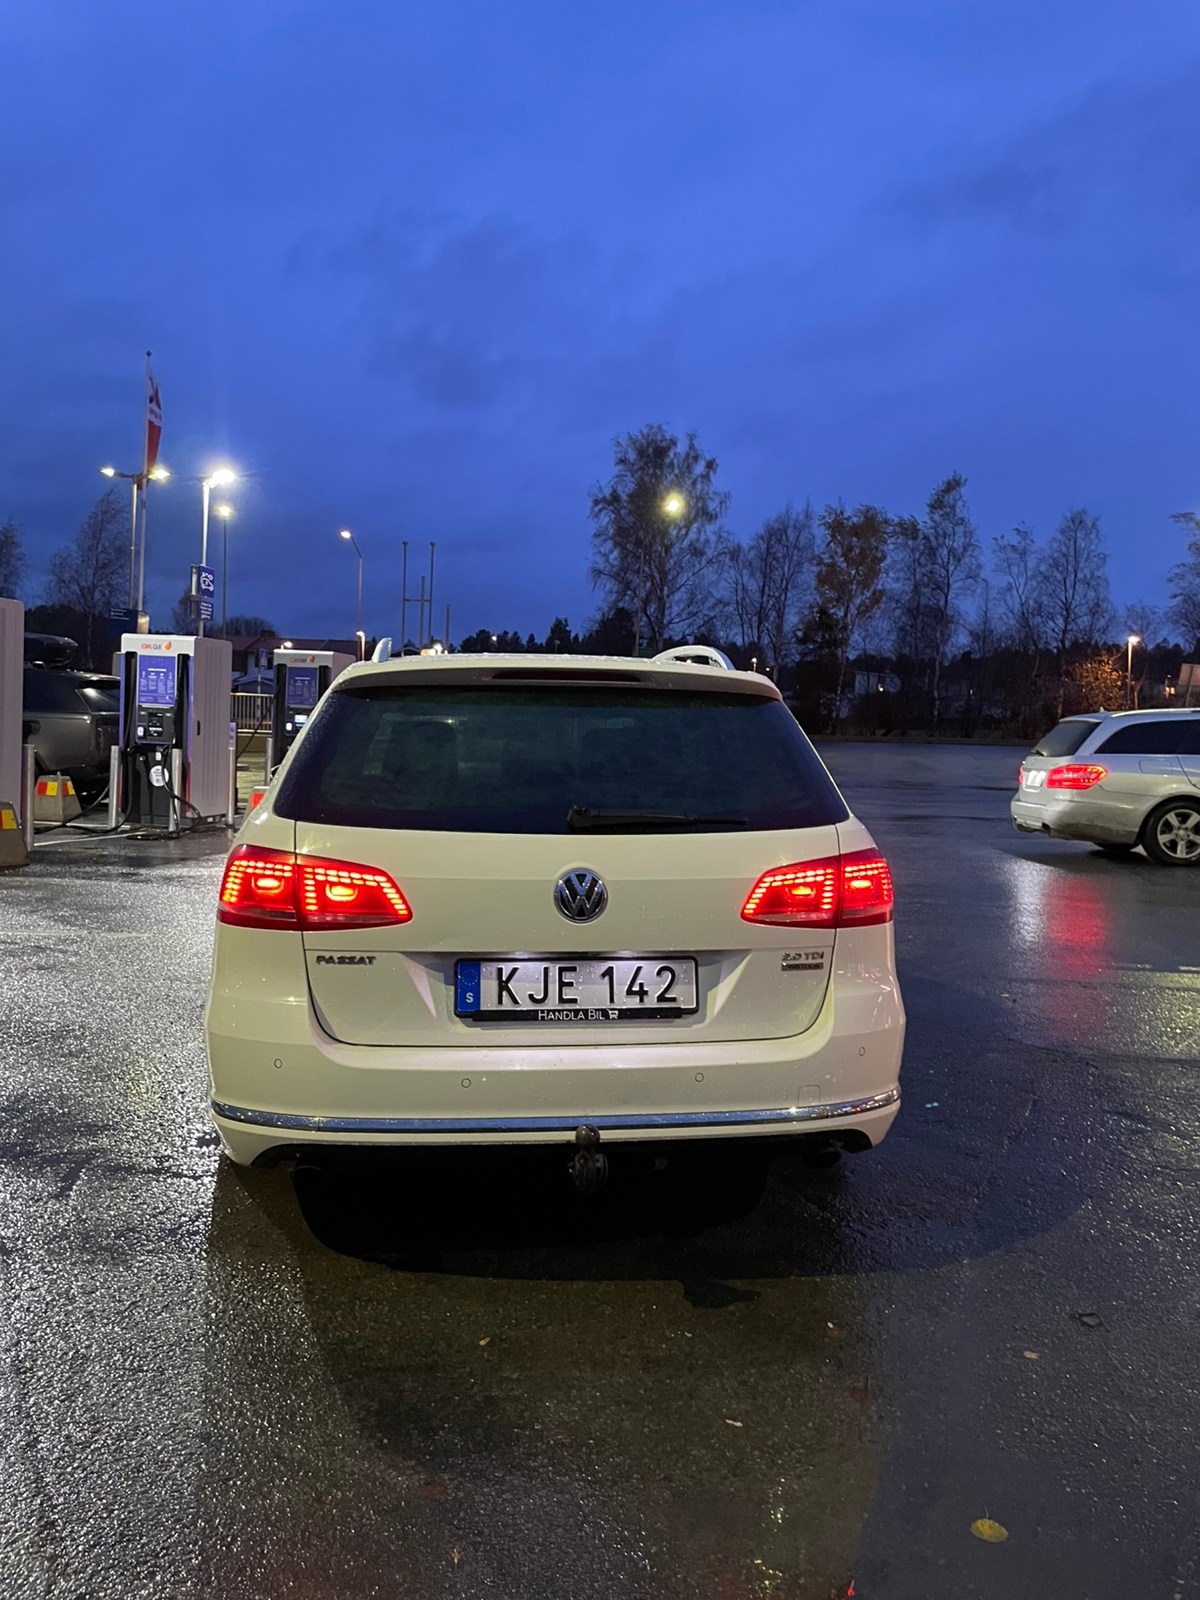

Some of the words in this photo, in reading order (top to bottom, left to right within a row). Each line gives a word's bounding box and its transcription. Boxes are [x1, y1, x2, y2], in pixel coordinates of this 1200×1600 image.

[316, 955, 377, 966] PASSAT
[781, 951, 802, 962] 2.0
[804, 951, 825, 961] TDI
[497, 966, 579, 1005] KJE
[600, 965, 678, 1004] 142
[465, 992, 474, 1003] S
[538, 1009, 585, 1021] HANDLA
[588, 1009, 605, 1020] BIL
